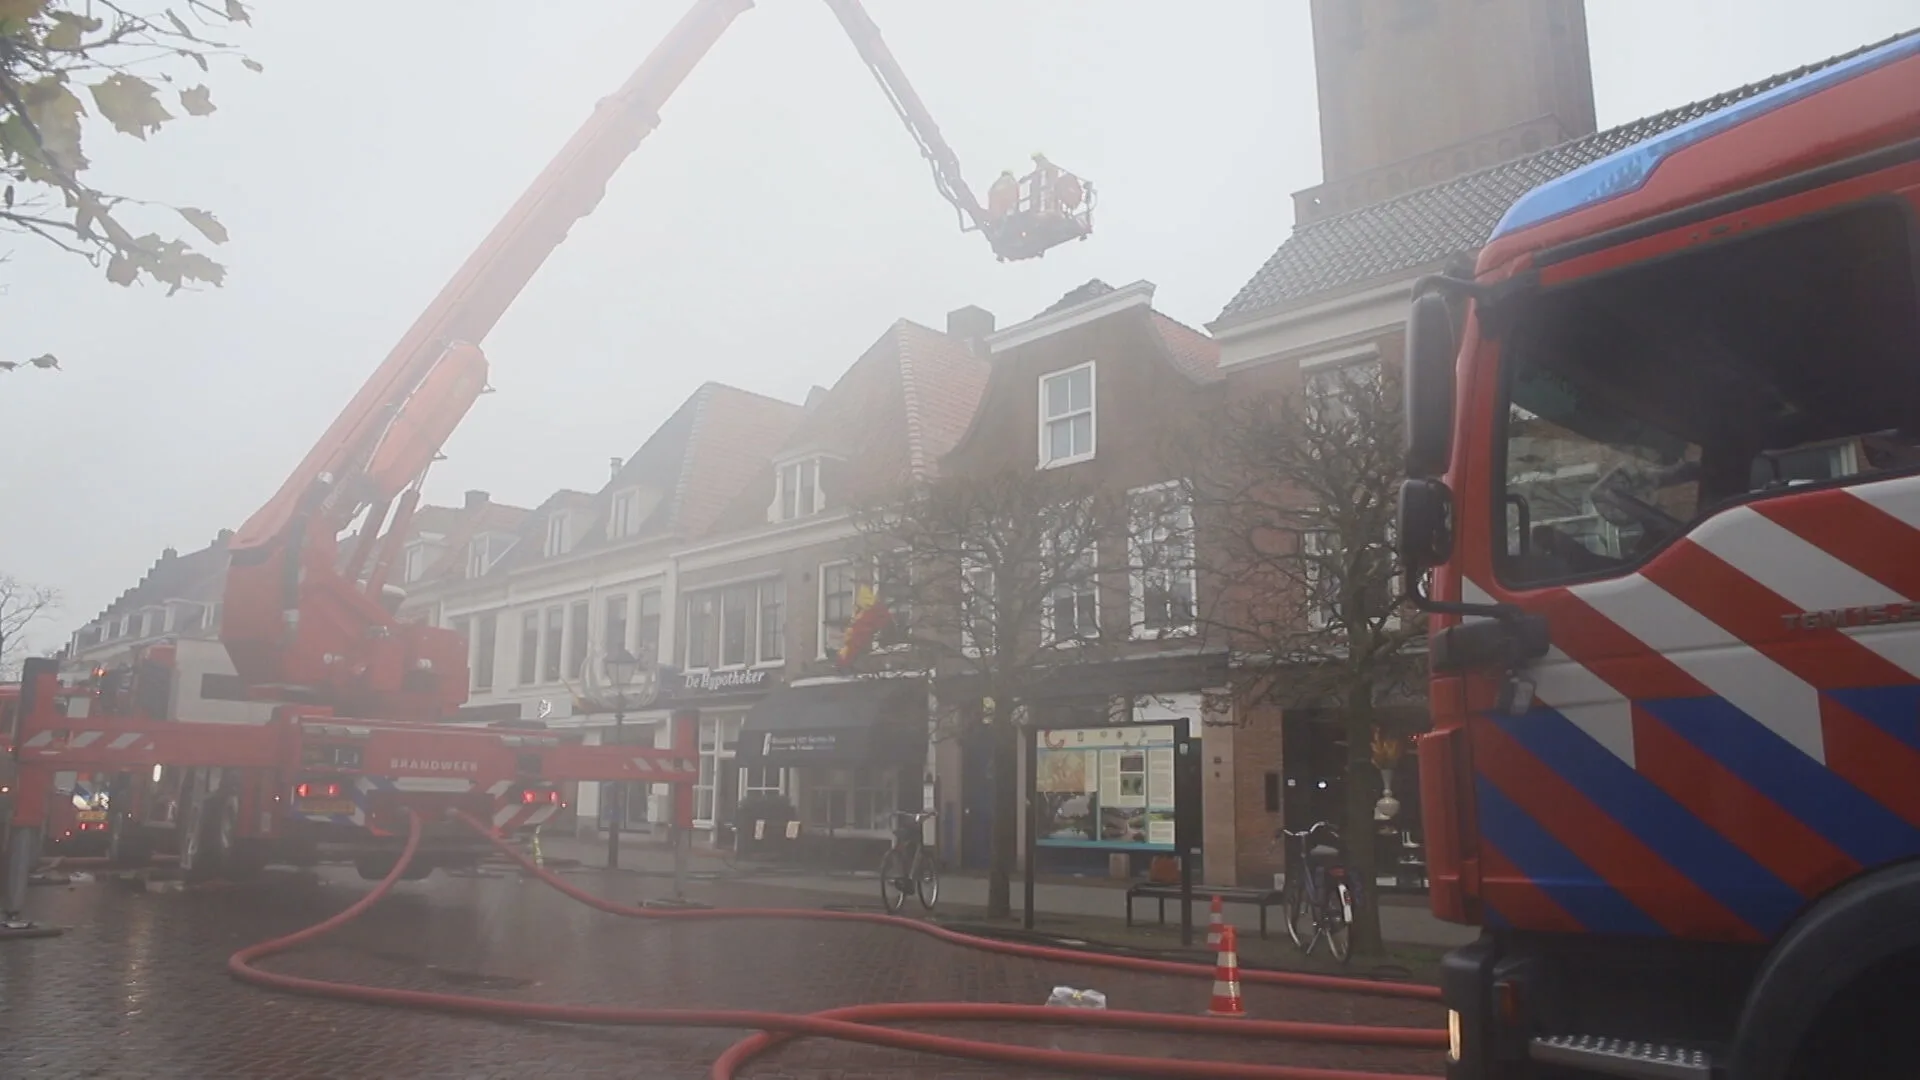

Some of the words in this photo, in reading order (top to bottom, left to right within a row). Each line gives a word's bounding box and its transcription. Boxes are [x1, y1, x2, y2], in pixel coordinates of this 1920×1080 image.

[685, 675, 700, 689] De
[701, 670, 766, 690] Hypotheker
[390, 757, 479, 772] BRANDWEER
